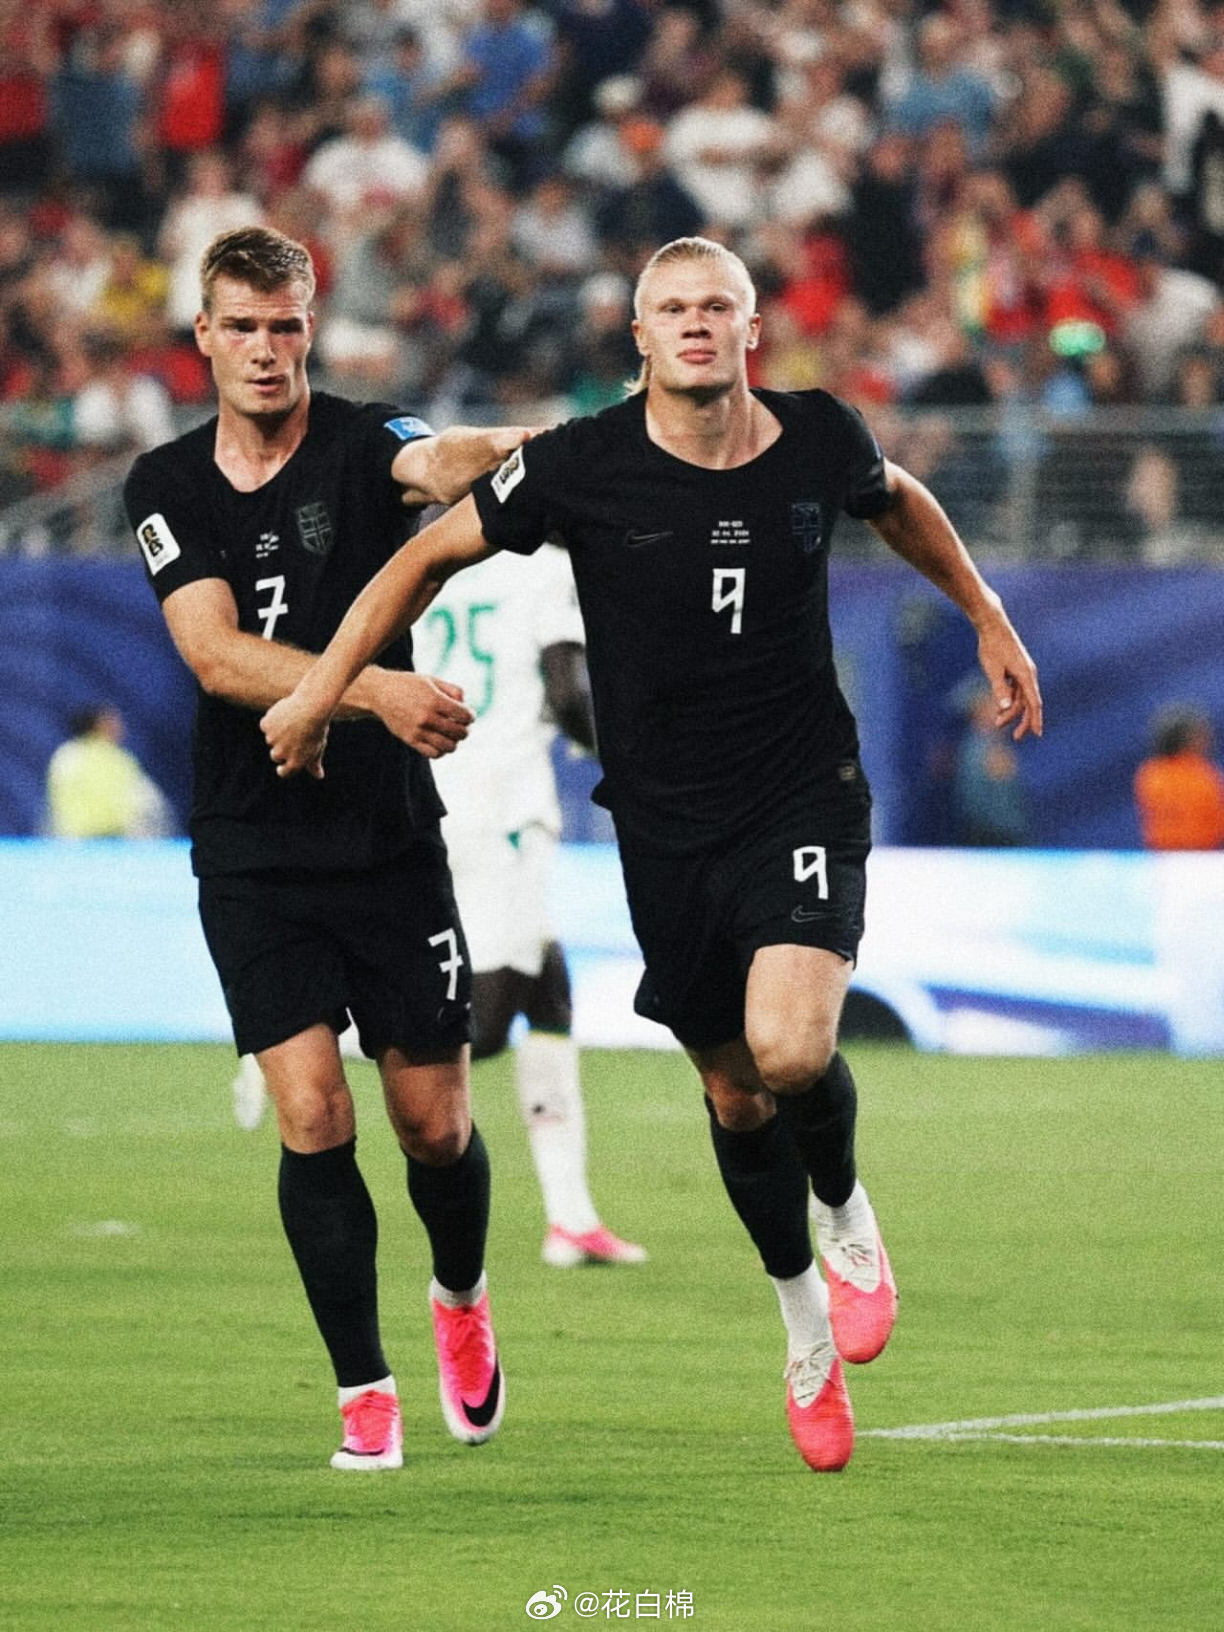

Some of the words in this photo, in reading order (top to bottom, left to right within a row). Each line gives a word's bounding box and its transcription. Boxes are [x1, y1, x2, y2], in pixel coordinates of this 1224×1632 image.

[255, 574, 289, 640] 7
[711, 567, 746, 634] 9
[424, 602, 497, 719] 25
[793, 845, 828, 900] 9
[428, 927, 464, 1001] 7
